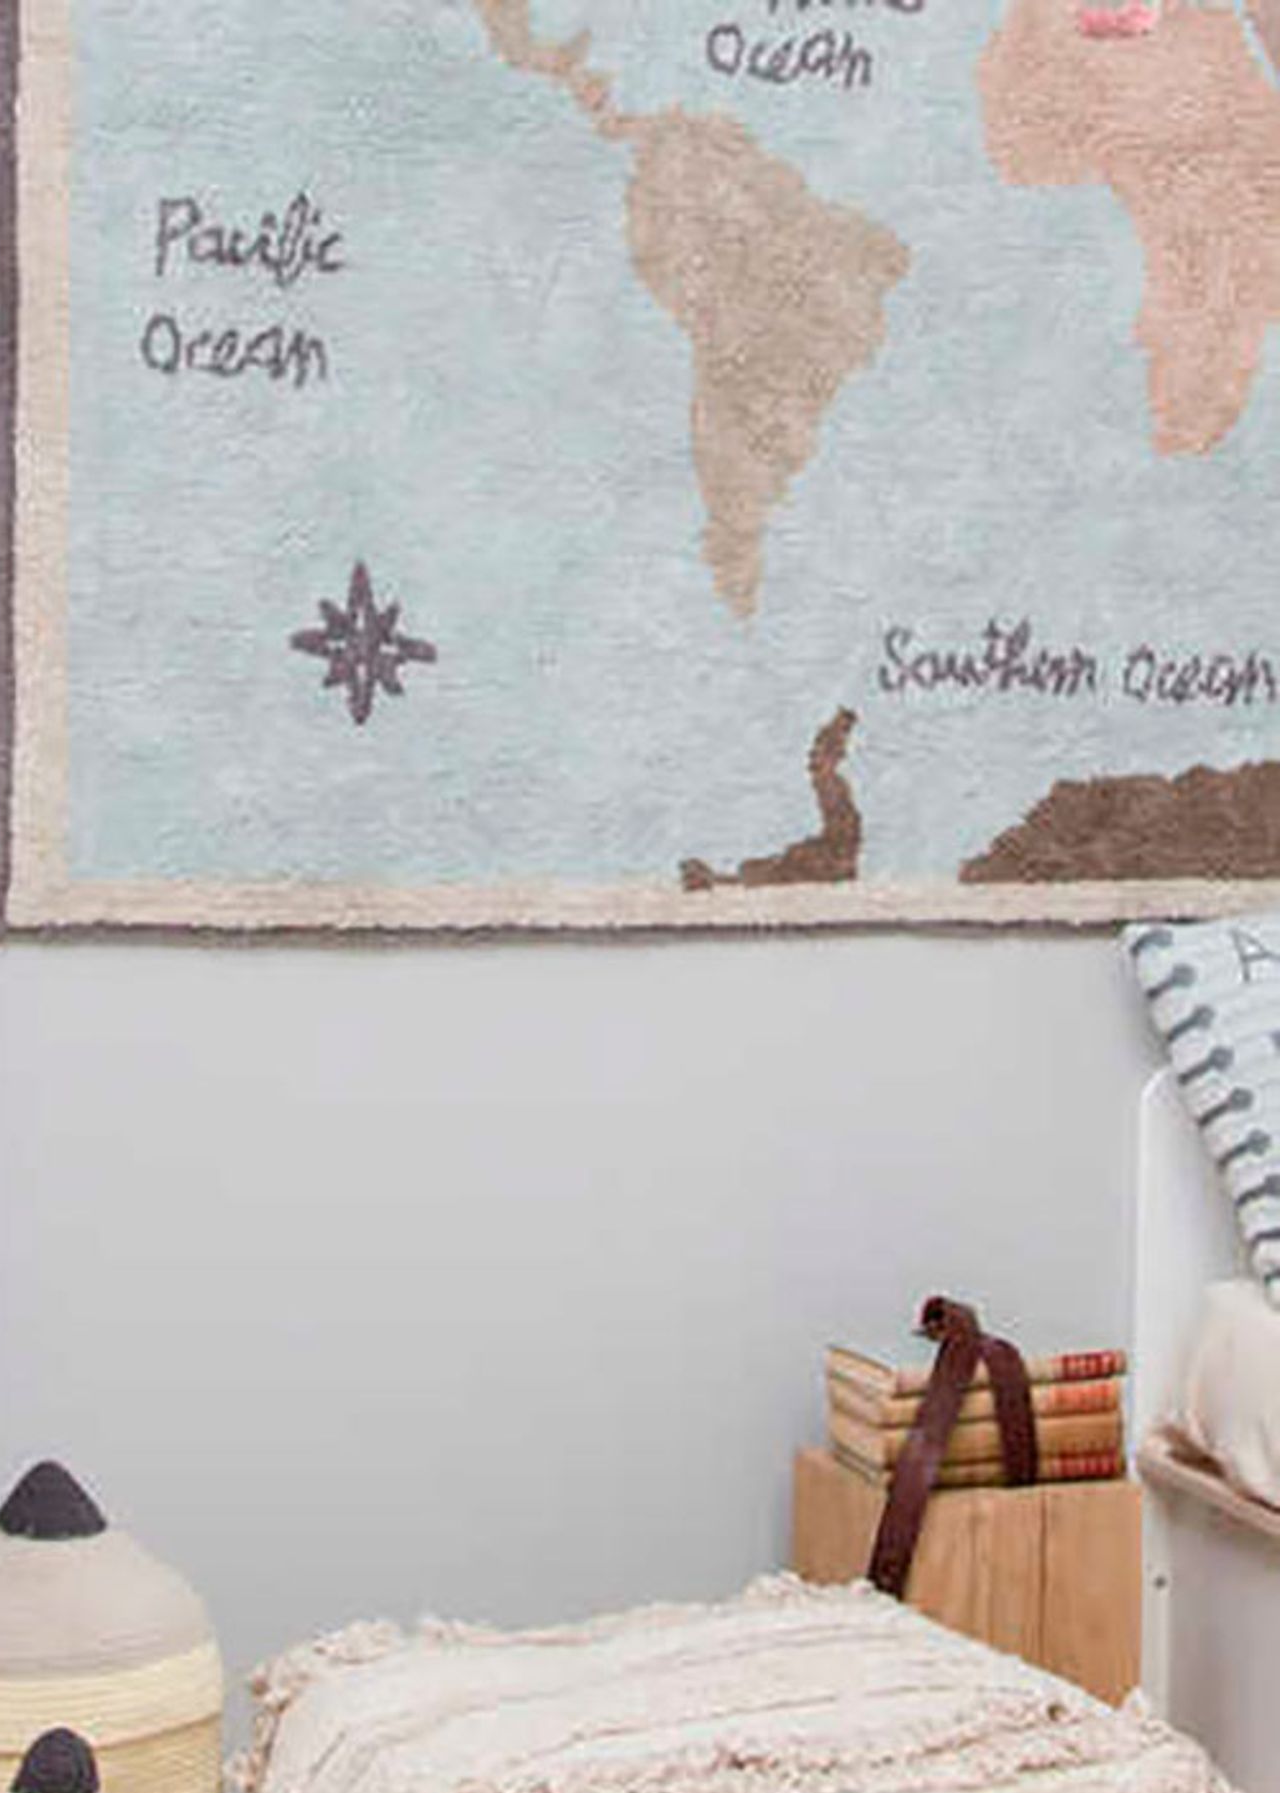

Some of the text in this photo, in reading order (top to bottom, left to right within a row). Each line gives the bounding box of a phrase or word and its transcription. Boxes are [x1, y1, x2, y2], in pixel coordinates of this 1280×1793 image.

[706, 23, 874, 90] Ocean
[154, 192, 344, 289] Pacific
[141, 314, 329, 390] Ocean
[879, 616, 1097, 698] Southern
